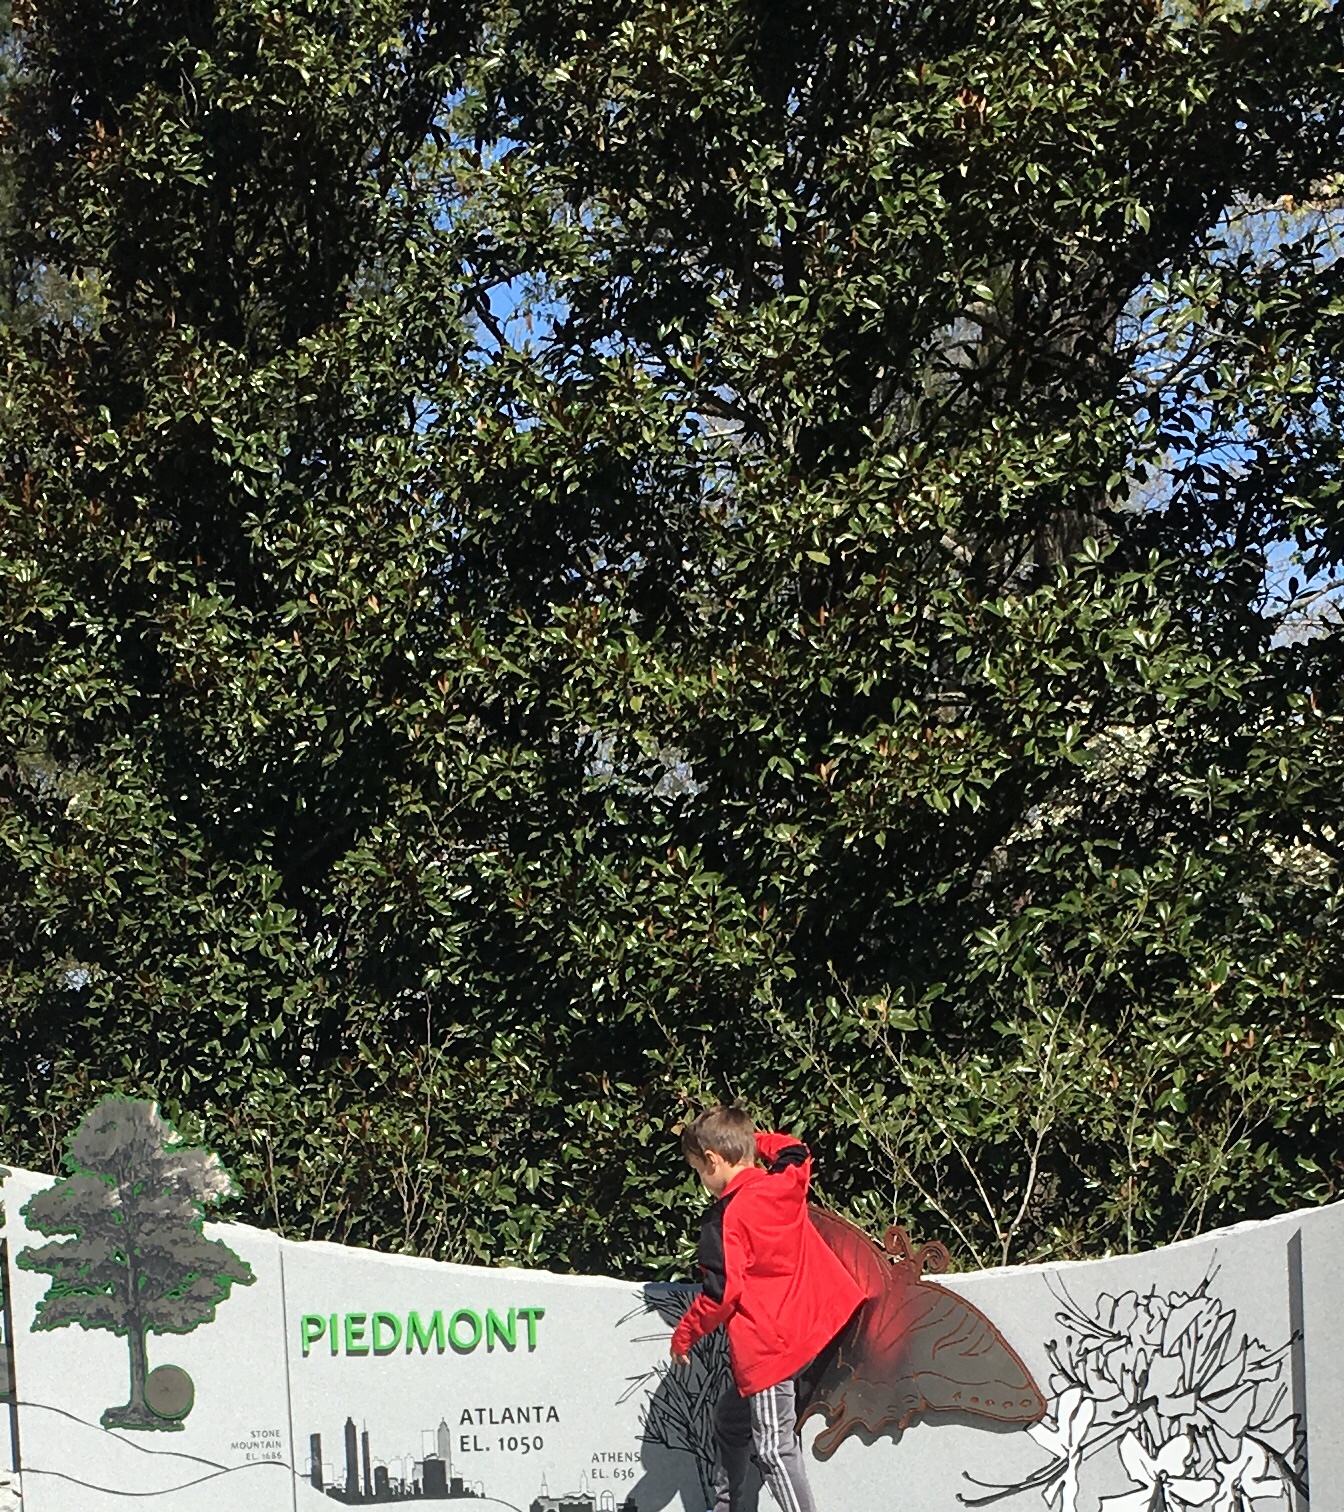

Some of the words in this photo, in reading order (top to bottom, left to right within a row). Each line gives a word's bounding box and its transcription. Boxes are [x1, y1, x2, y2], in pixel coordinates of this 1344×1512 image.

[300, 1306, 546, 1356] PIEDMONT
[458, 1406, 561, 1426] ATLANTA
[250, 1429, 282, 1439] STONE
[230, 1440, 283, 1451] MOUNTAIN
[459, 1435, 491, 1452] EL.
[497, 1435, 545, 1455] 1050
[591, 1451, 642, 1464] ATHENS
[591, 1467, 610, 1479] EL.
[612, 1466, 636, 1480] 636
